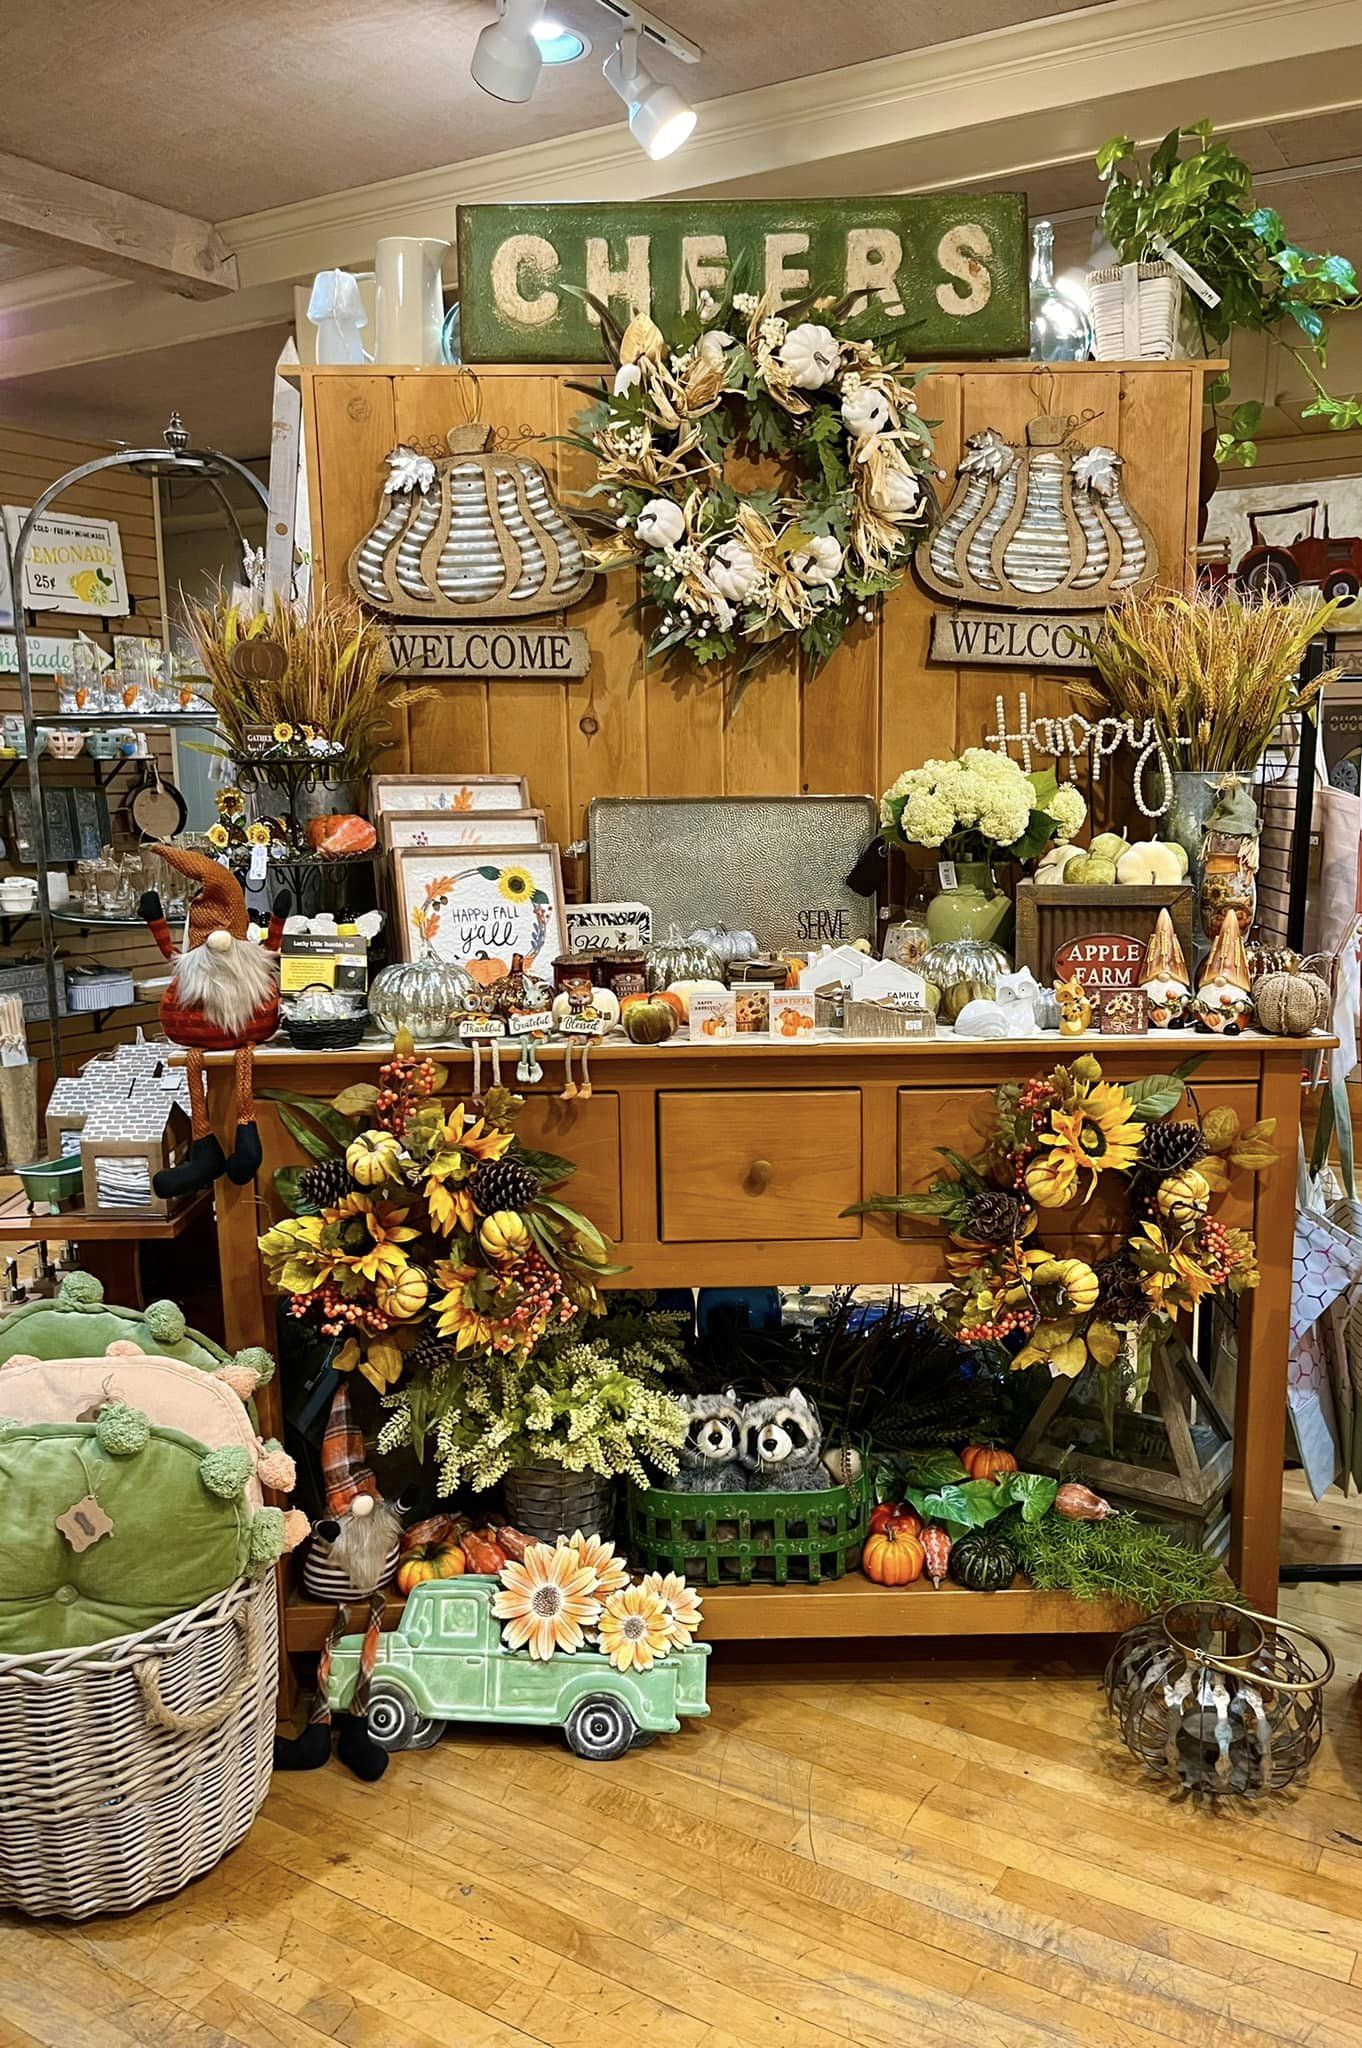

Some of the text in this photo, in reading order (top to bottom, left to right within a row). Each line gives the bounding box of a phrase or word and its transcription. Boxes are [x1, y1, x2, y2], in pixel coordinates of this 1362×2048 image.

[490, 222, 993, 328] CHEERS
[25, 544, 116, 567] EMONADE
[384, 633, 573, 670] WELCOME
[949, 620, 1115, 661] WELCOM
[984, 692, 1193, 818] Happy
[452, 905, 521, 924] HAPPY FALL
[797, 909, 850, 940] SERVE
[460, 921, 519, 954] y'all
[1067, 944, 1140, 962] APPLE
[1074, 966, 1133, 987] FARM
[886, 991, 921, 1000] FAMILY
[512, 1014, 549, 1032] Grateful
[564, 1016, 601, 1031] Blessed
